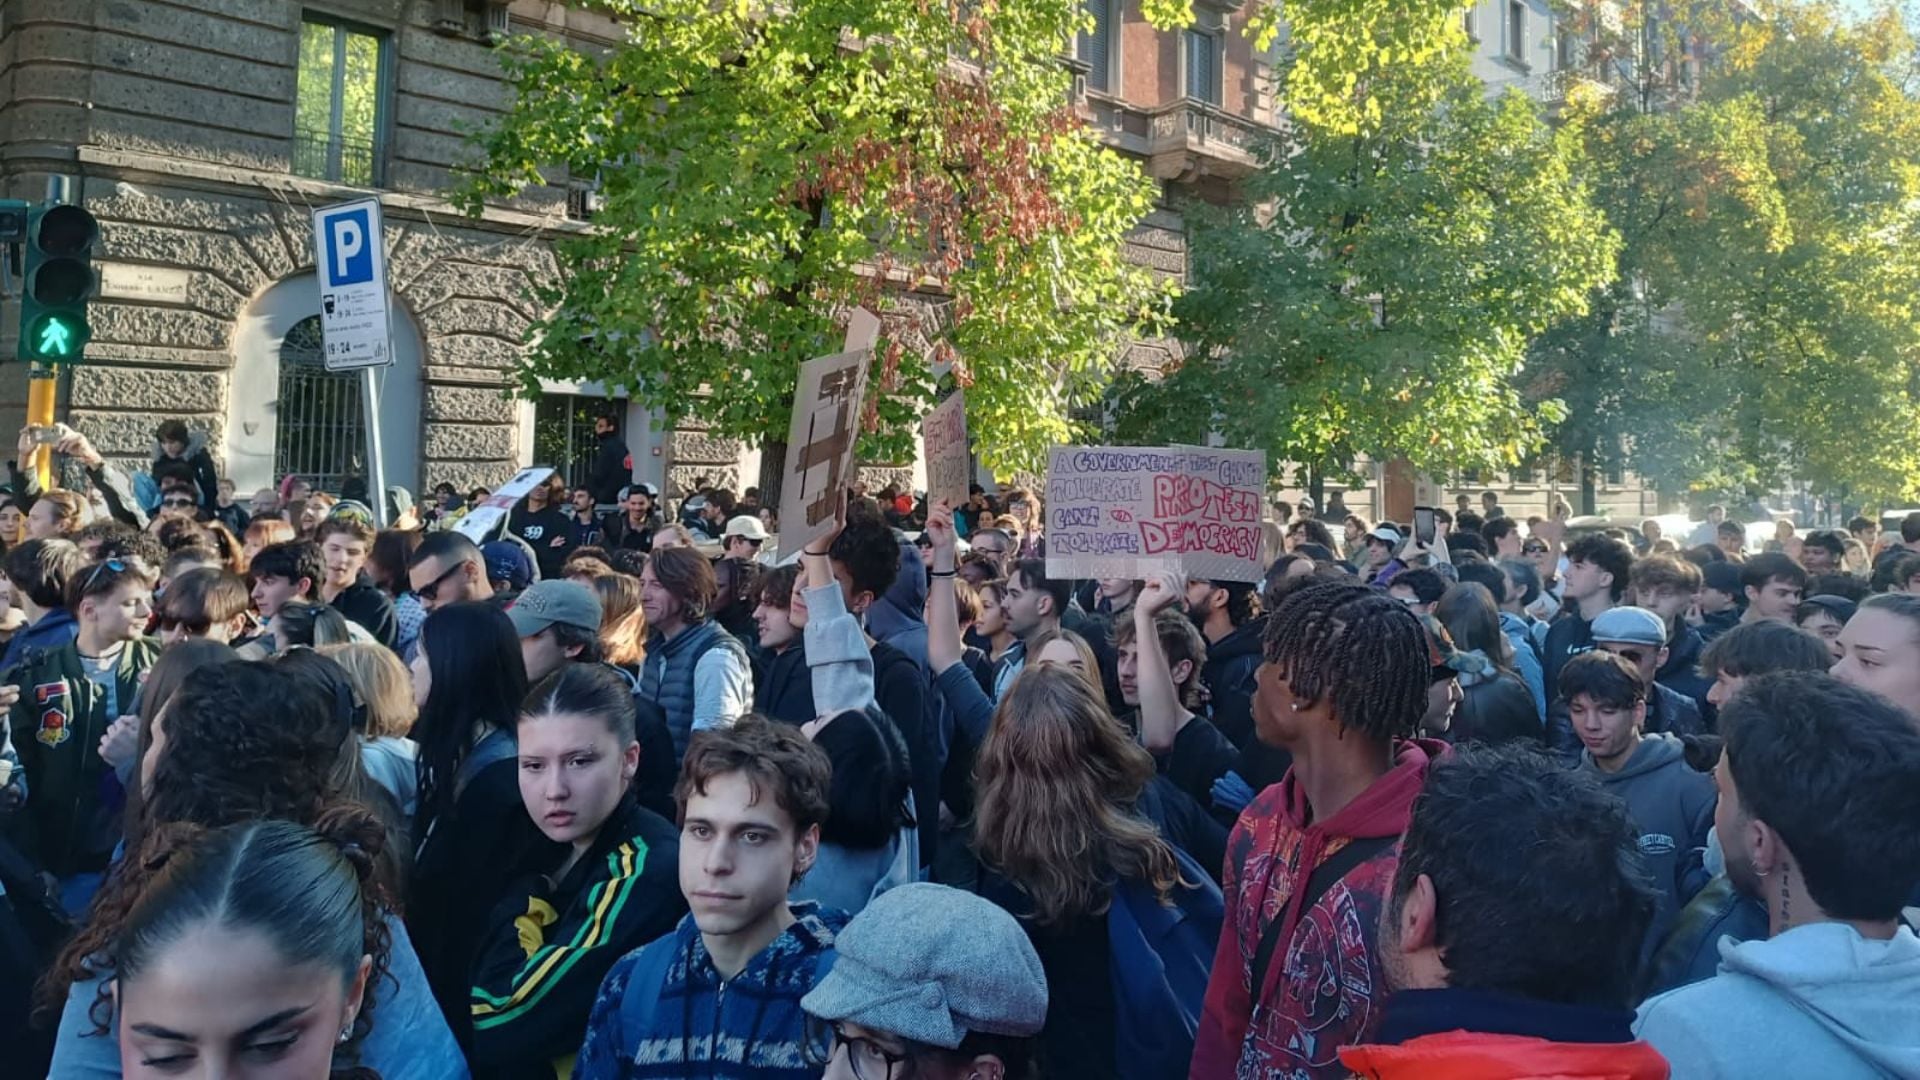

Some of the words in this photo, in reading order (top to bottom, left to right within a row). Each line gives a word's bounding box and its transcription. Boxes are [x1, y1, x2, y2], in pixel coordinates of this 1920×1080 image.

[334, 219, 362, 277] P
[1055, 453, 1072, 473] A
[1154, 474, 1259, 522] PROTEST
[1138, 520, 1262, 560] DEMOCRACY
